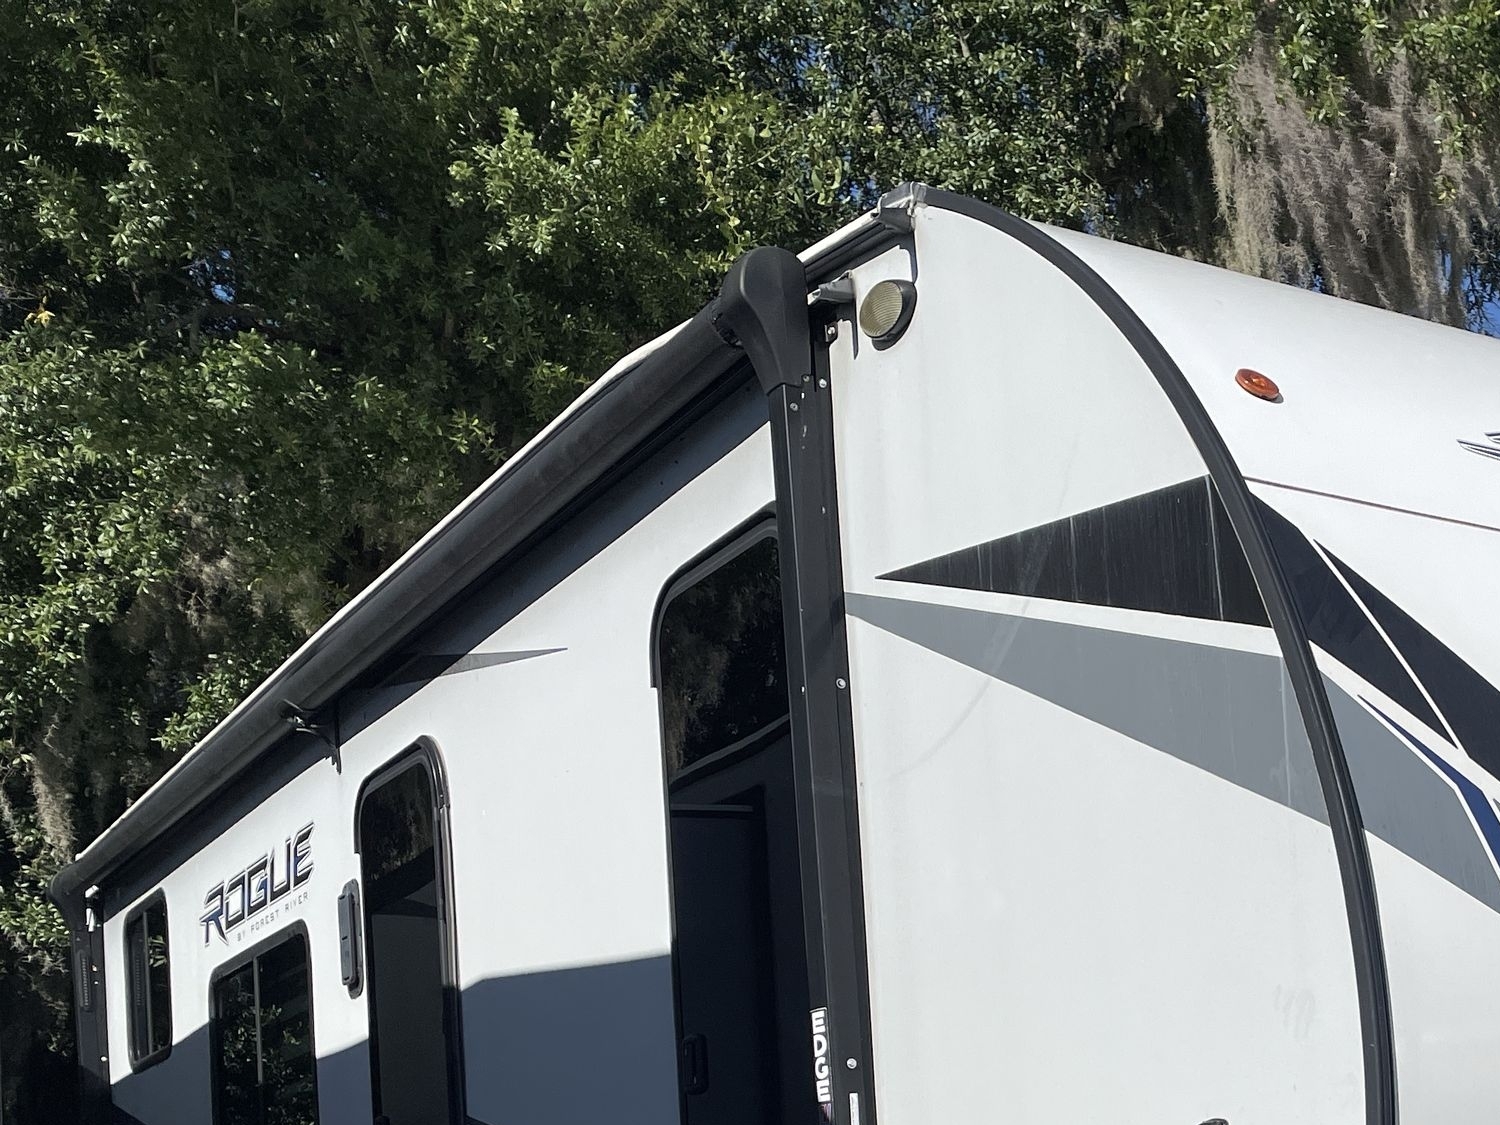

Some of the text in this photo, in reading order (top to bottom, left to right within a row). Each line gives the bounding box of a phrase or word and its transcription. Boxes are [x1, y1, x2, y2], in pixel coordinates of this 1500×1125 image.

[199, 819, 315, 947] ROGUE
[250, 909, 279, 934] FOREST
[284, 891, 308, 912] RIVER
[811, 1010, 831, 1103] EDGE
